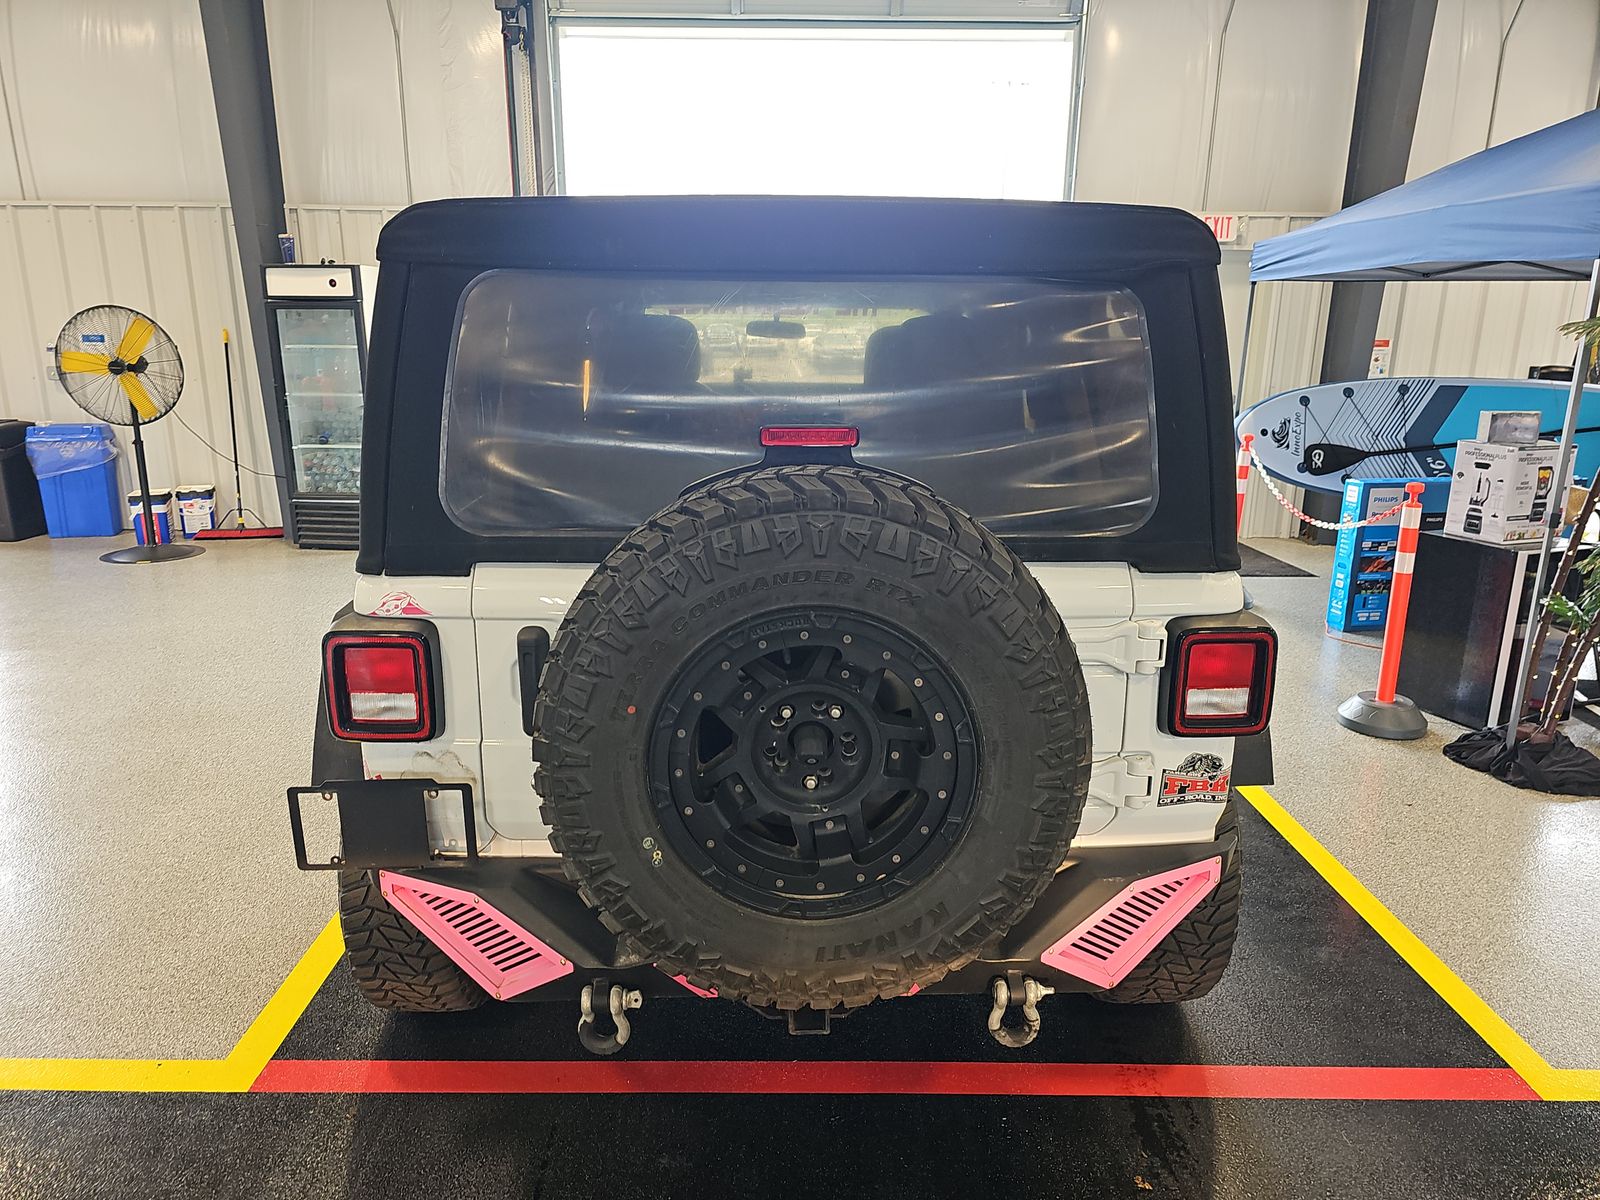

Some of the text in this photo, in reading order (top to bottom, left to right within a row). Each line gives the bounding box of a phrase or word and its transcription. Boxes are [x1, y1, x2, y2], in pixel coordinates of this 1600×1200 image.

[1291, 411, 1305, 457] InnoExpo
[671, 569, 856, 635] COMMANDER
[864, 578, 922, 606] RTX
[1164, 774, 1230, 795] FBK
[815, 901, 950, 962] KANATI
